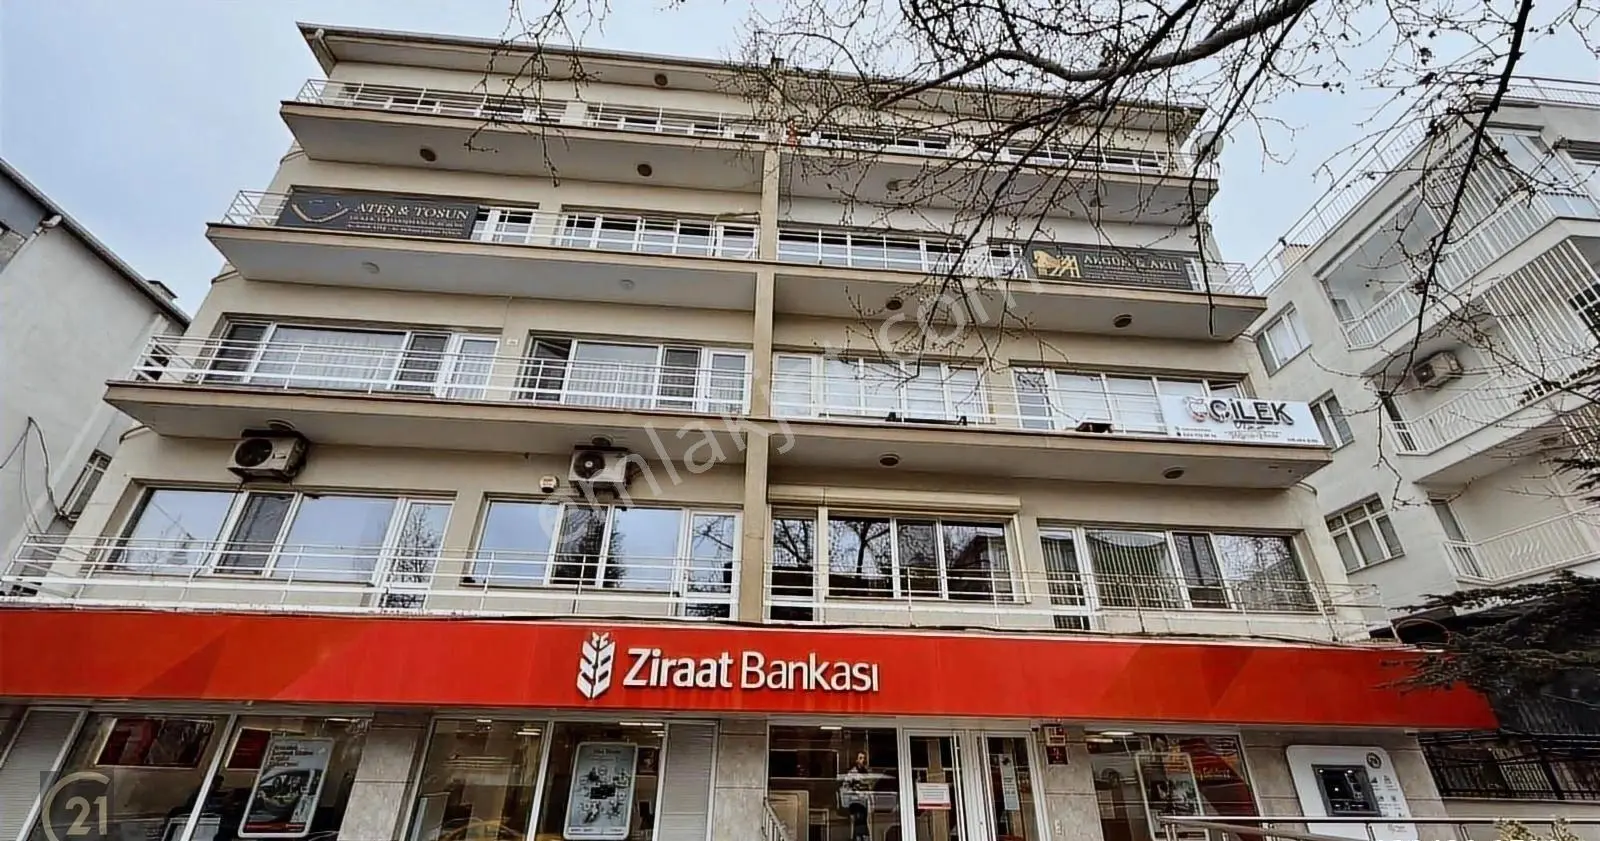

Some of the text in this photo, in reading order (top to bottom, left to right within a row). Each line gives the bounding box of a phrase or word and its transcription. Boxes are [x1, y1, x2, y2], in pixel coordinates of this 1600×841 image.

[354, 202, 469, 220] ATEŞ & TOSUN
[622, 647, 880, 692] Ziraat Bankası
